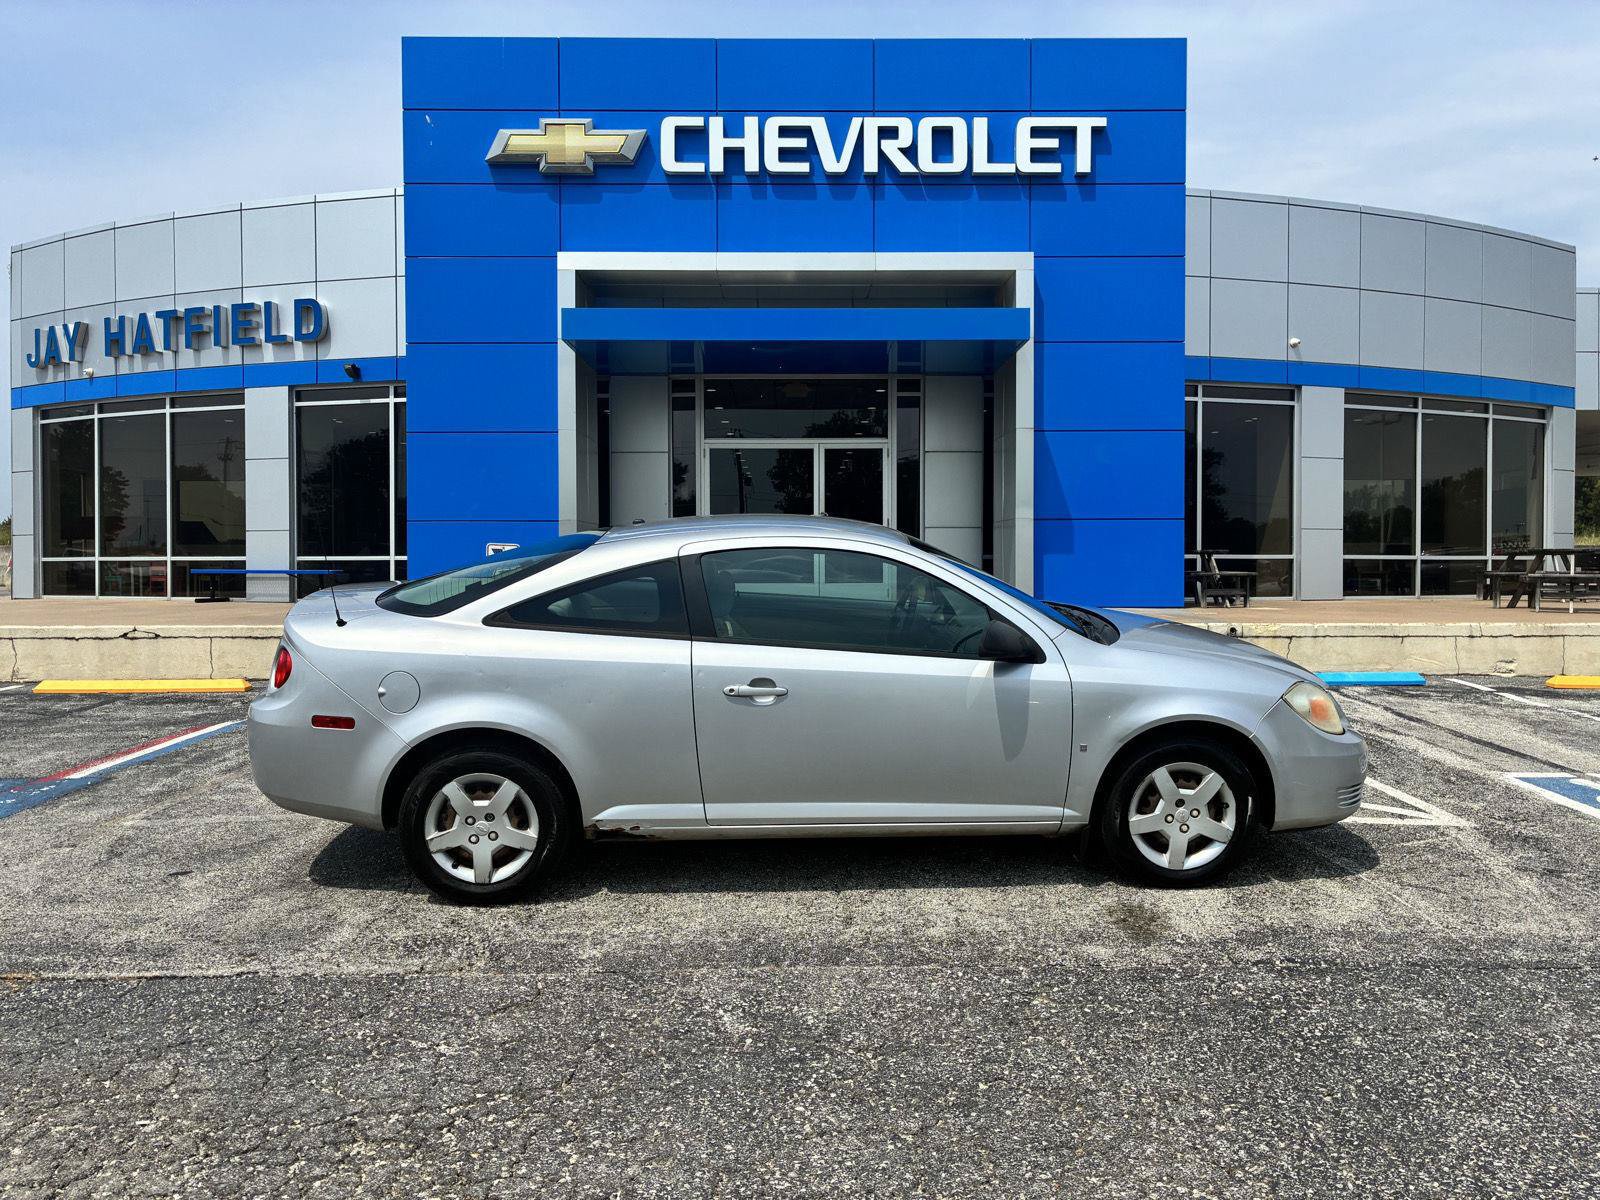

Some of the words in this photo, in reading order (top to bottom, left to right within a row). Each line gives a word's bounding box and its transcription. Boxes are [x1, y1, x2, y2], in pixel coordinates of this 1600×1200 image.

[660, 116, 1107, 175] CHEVROLET
[27, 321, 87, 368] JAY
[103, 298, 327, 357] HATFIELD
